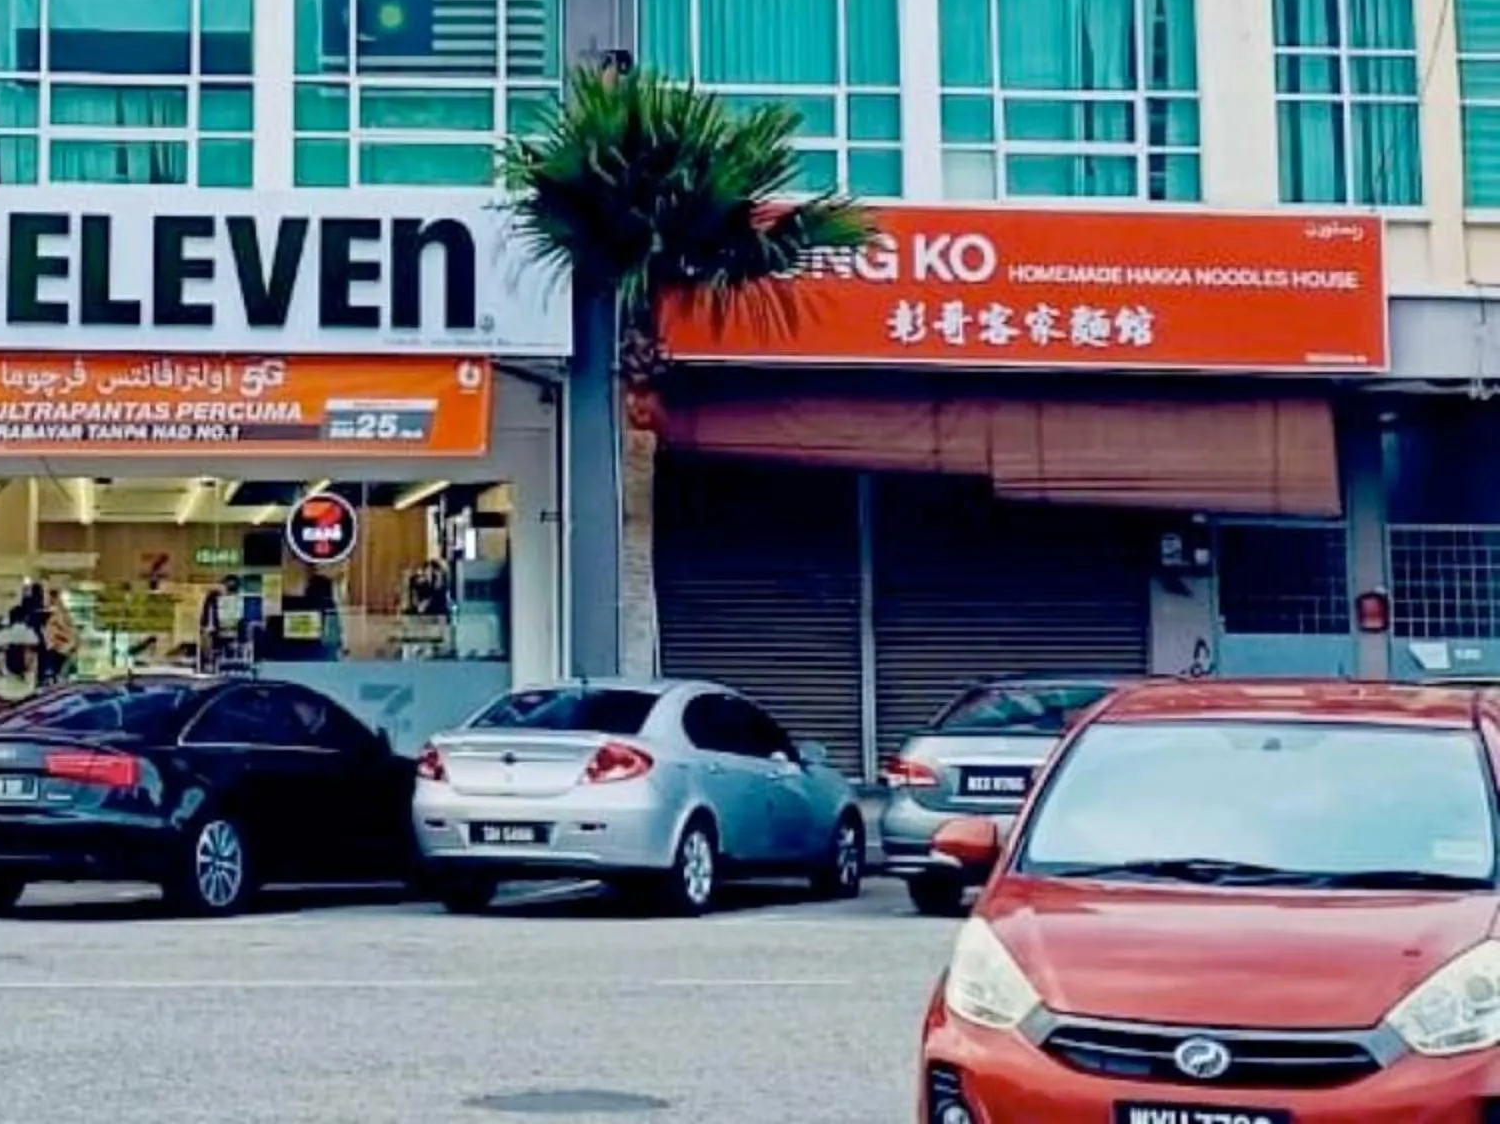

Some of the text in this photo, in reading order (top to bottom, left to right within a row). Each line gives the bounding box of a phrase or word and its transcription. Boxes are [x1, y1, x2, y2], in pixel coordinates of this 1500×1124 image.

[914, 232, 997, 283] KO
[1008, 264, 1360, 290] HOMEMADE HAKKA NOODLES HOUSE
[241, 360, 286, 397] 5G
[174, 401, 302, 422] PERCUMA
[88, 424, 148, 440] TANPA
[355, 414, 400, 439] 25
